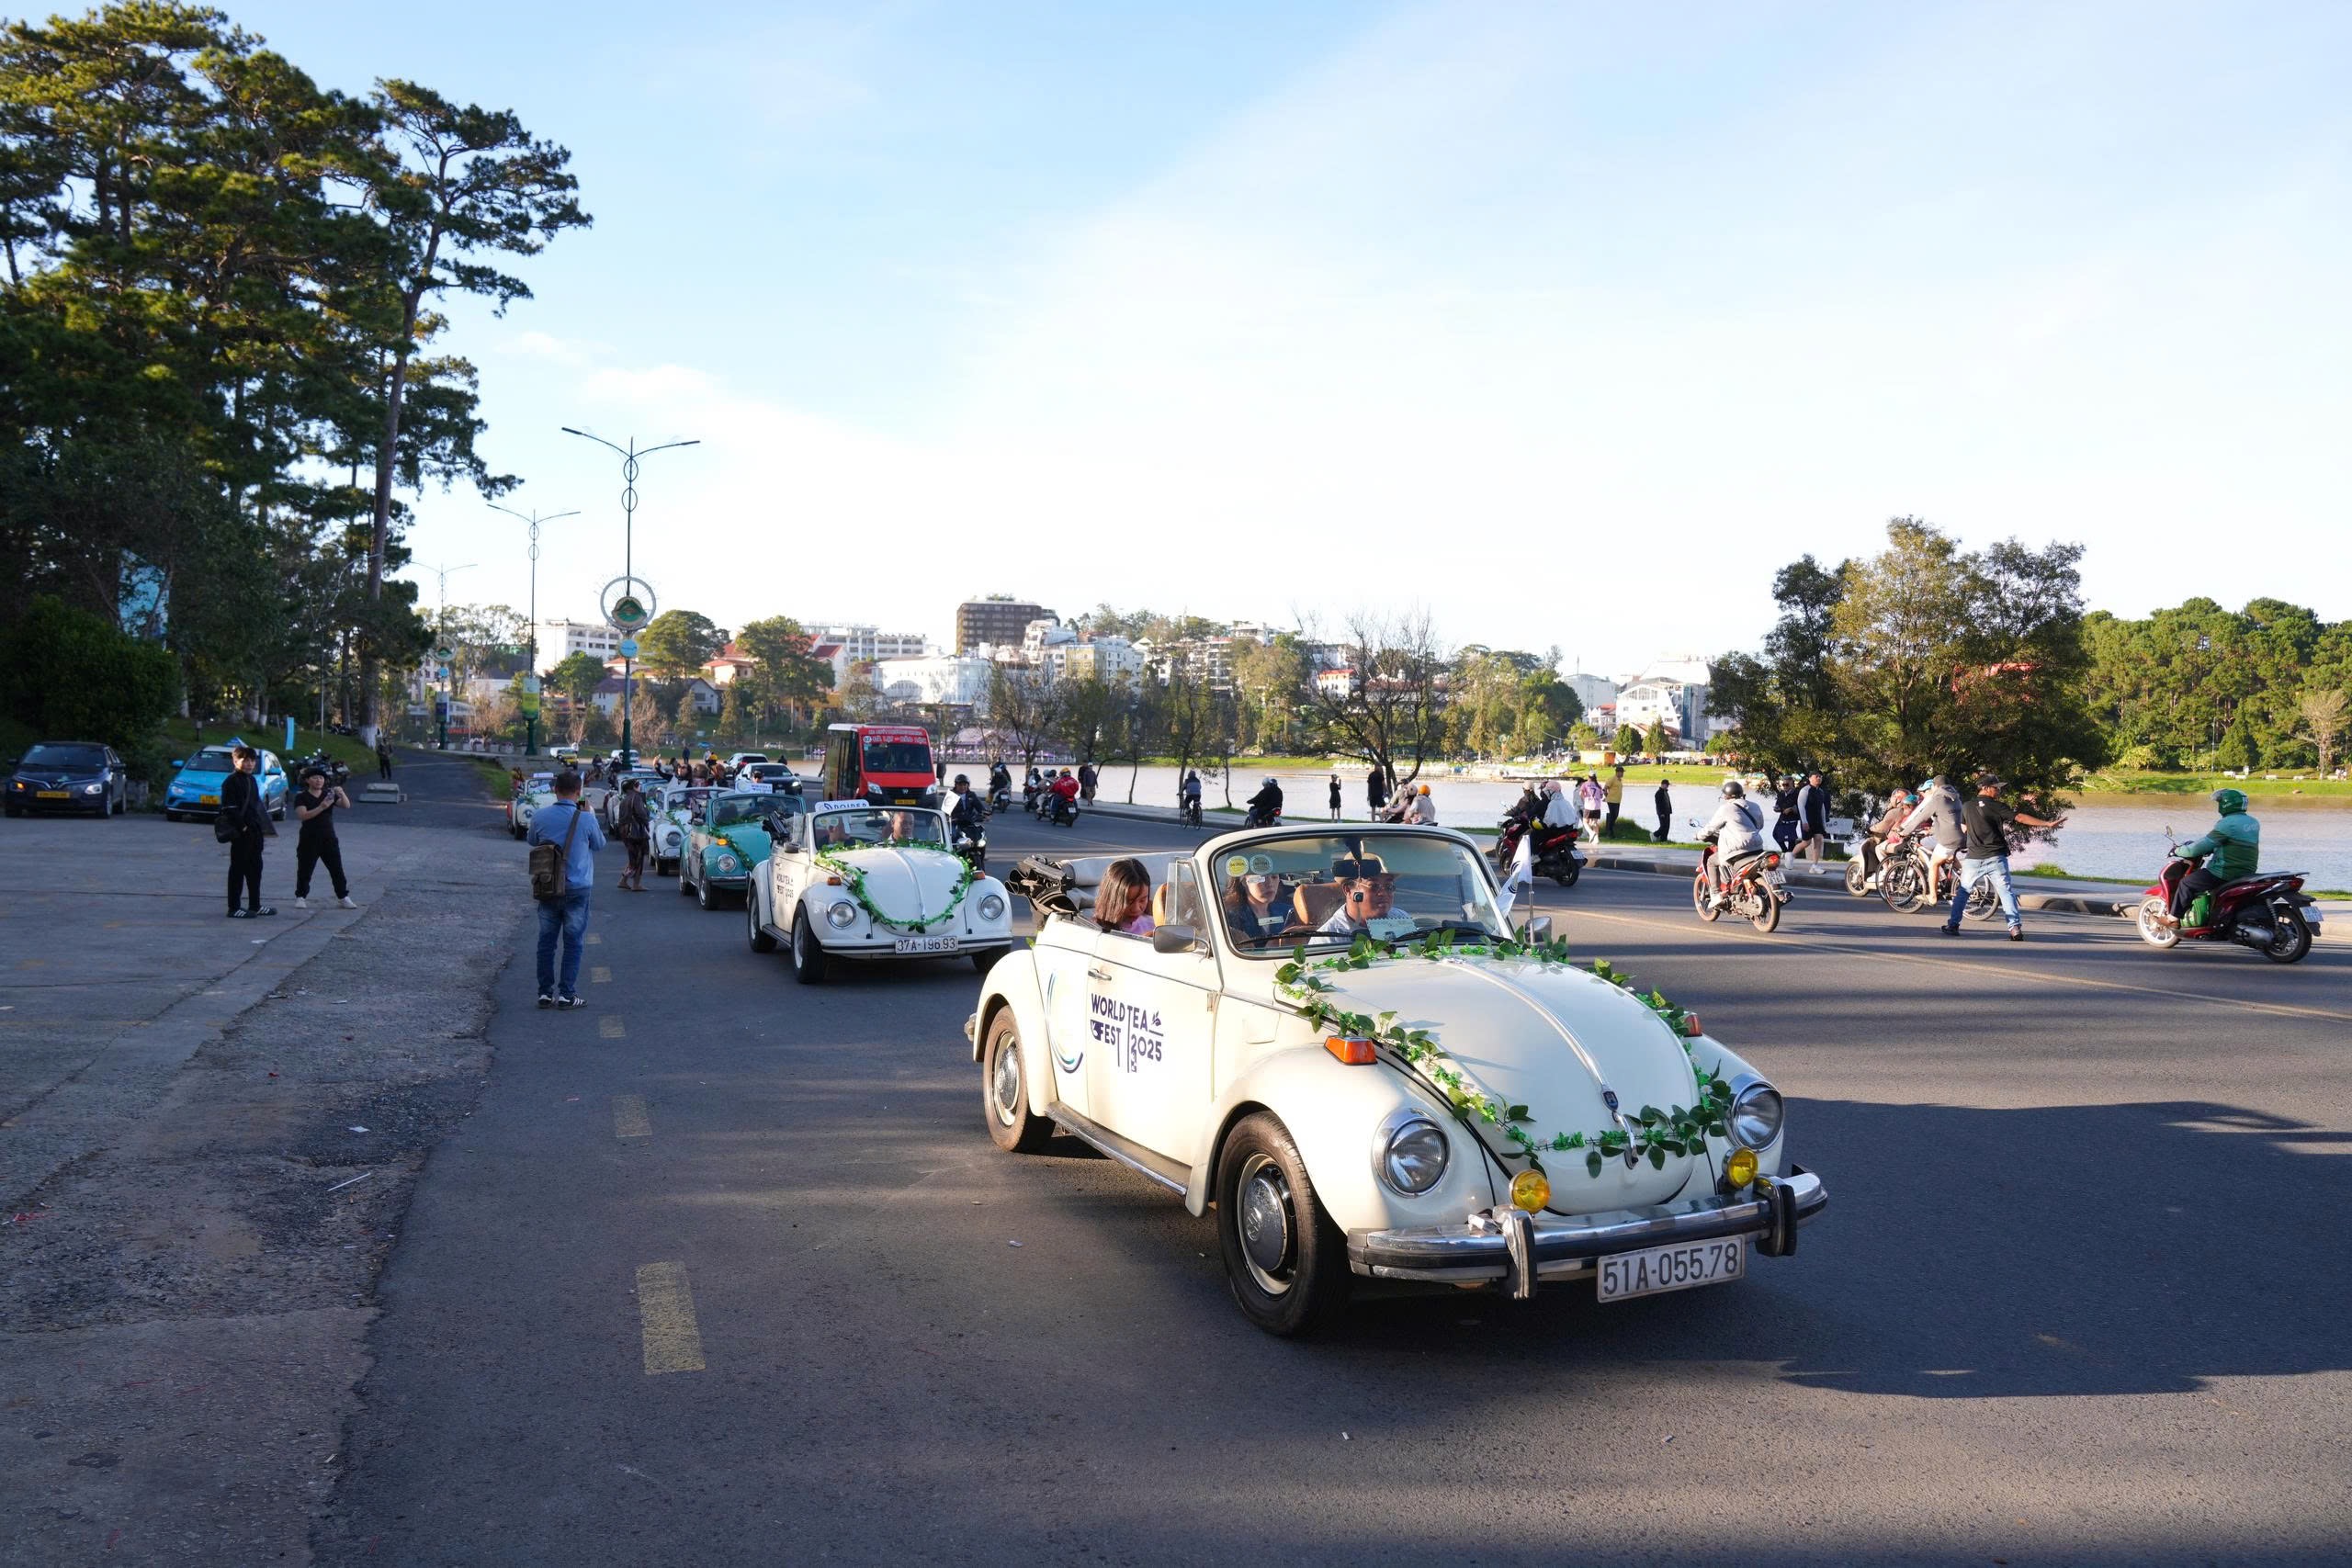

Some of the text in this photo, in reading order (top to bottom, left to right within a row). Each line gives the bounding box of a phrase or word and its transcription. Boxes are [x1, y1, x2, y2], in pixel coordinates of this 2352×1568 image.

[1091, 993, 1125, 1021] WORLD
[1131, 1034, 1161, 1062] 2025
[1603, 1242, 1738, 1295] 51A-055.78
